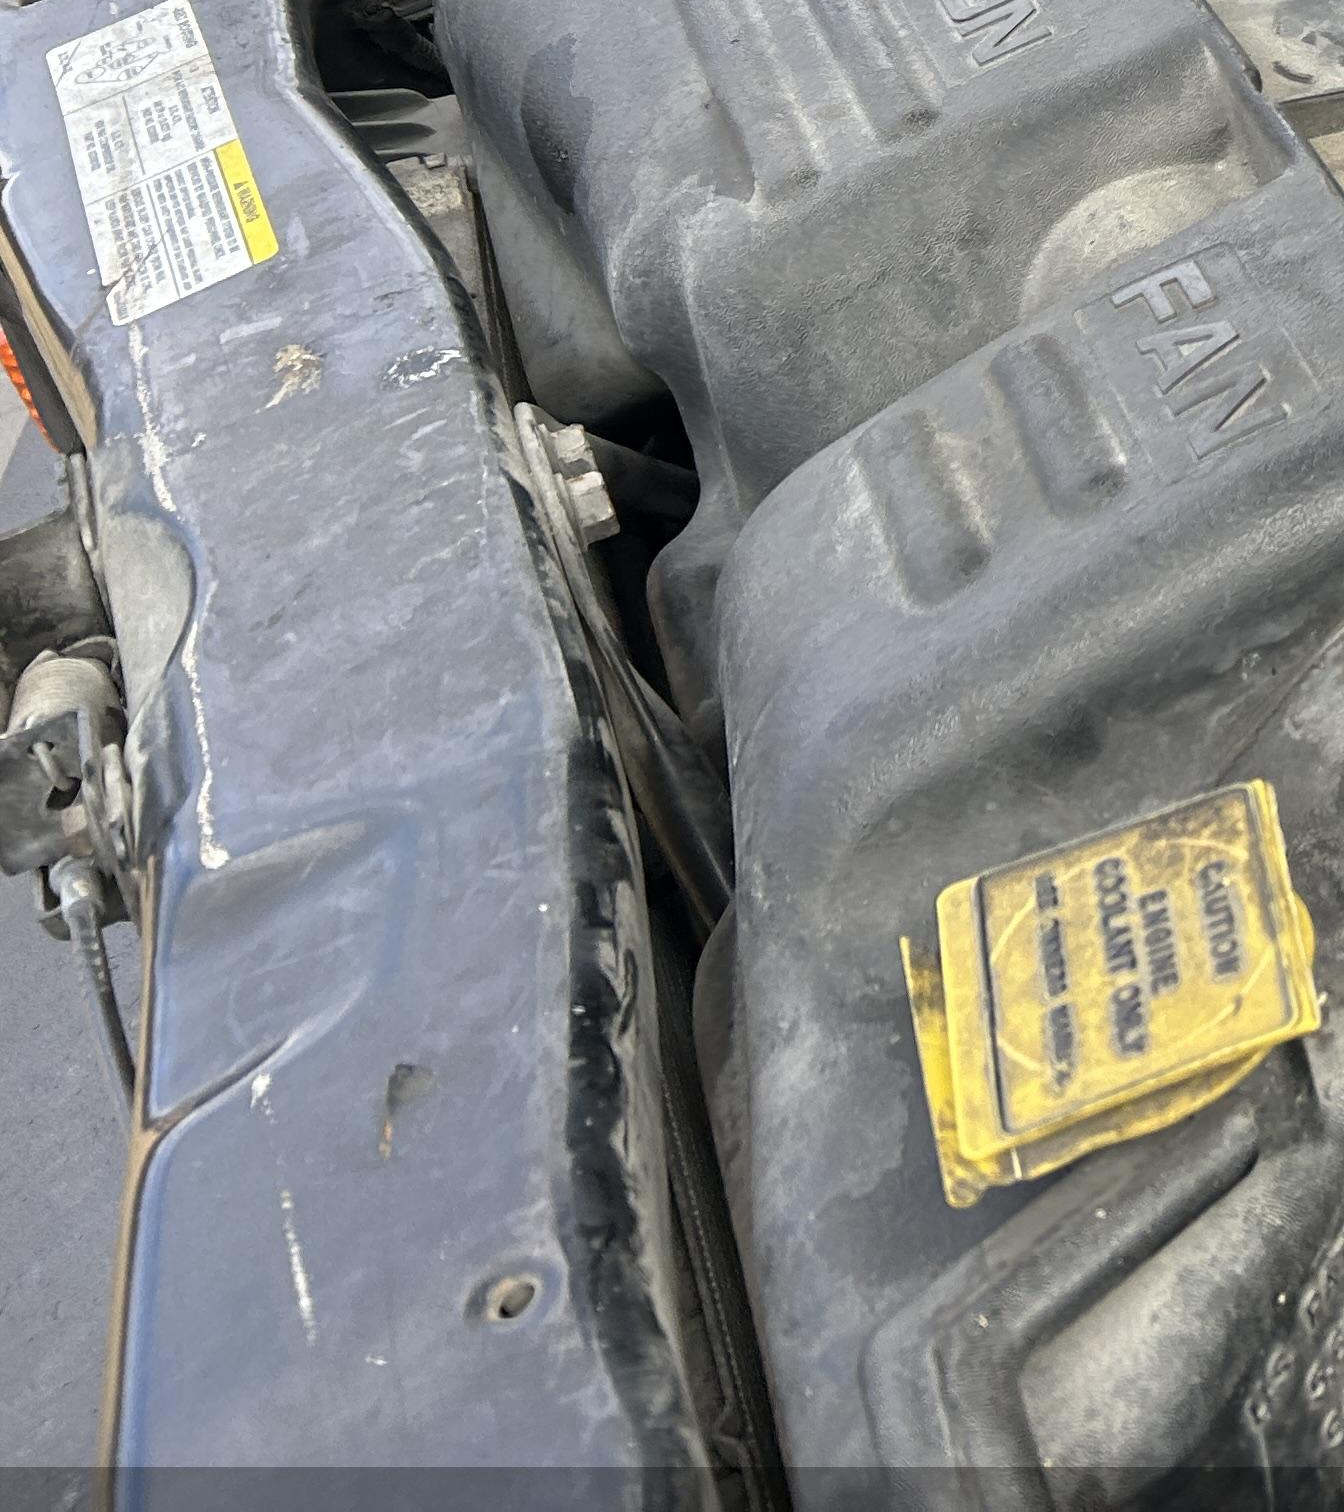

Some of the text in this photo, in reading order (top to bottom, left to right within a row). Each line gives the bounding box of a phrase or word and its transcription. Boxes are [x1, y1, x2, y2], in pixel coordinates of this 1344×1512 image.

[1110, 261, 1290, 460] FAN
[1083, 854, 1155, 1057] COOLANT ONLY
[1129, 888, 1189, 996] ENGINE
[1189, 859, 1251, 978] CAUTION
